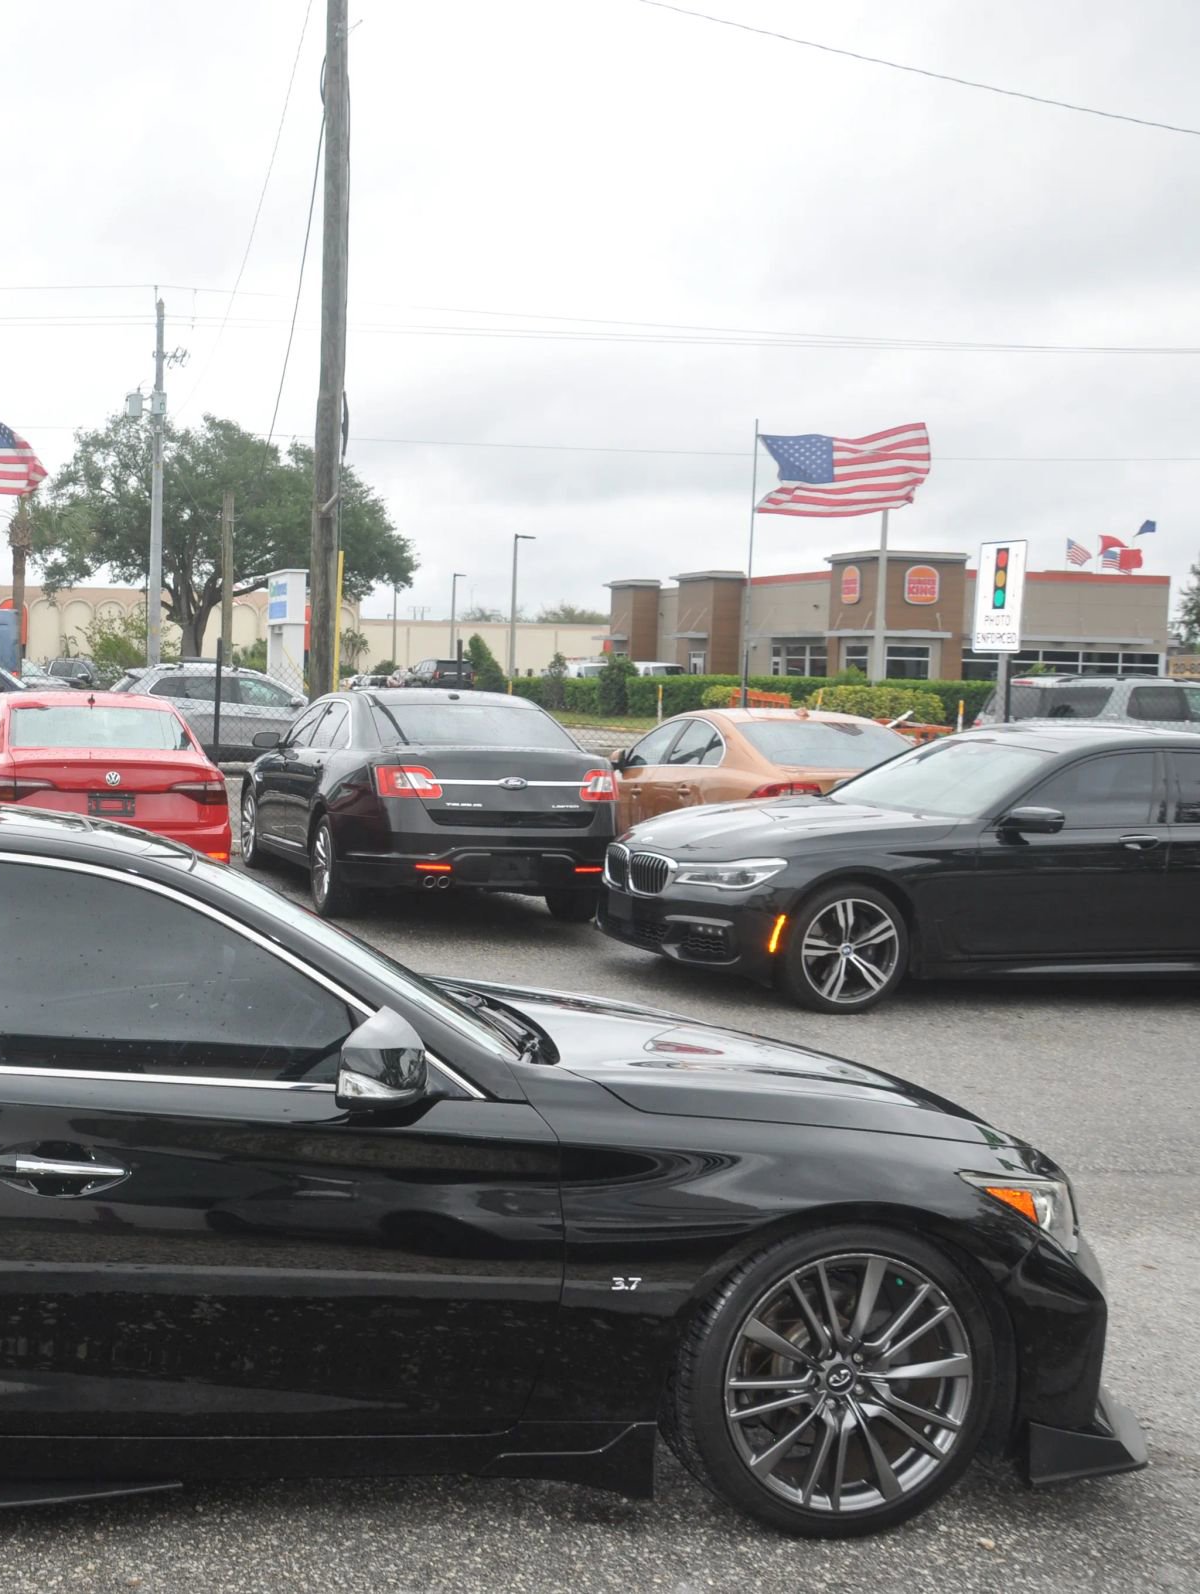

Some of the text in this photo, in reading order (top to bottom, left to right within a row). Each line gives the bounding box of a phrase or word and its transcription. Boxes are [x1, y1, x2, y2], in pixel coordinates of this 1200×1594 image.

[907, 585, 937, 597] KING
[984, 614, 1011, 627] PHOTO
[976, 632, 1017, 644] ENFORCED
[611, 1277, 642, 1290] 3.7
